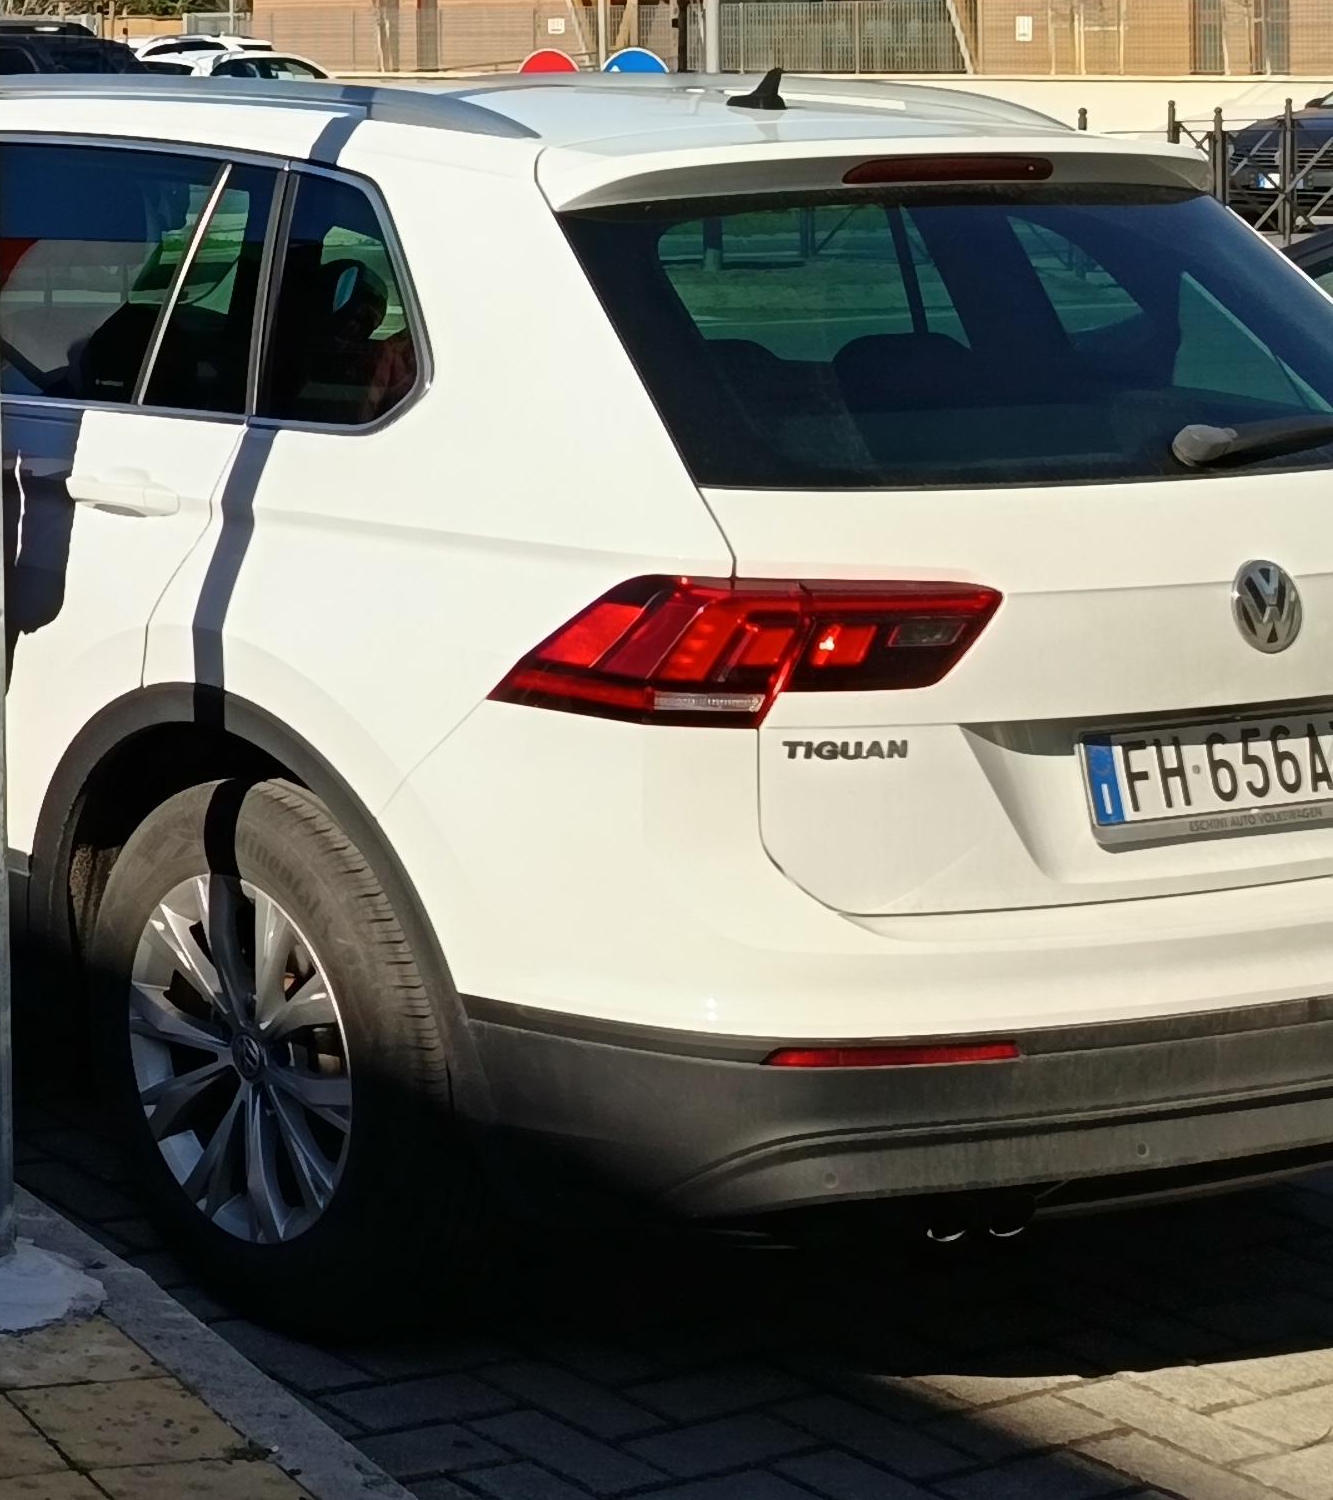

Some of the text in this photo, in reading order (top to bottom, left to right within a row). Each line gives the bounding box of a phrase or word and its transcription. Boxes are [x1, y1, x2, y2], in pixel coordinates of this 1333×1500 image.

[782, 739, 908, 760] TIGUAN
[1121, 735, 1192, 812] FH
[1206, 721, 1333, 802] 656A
